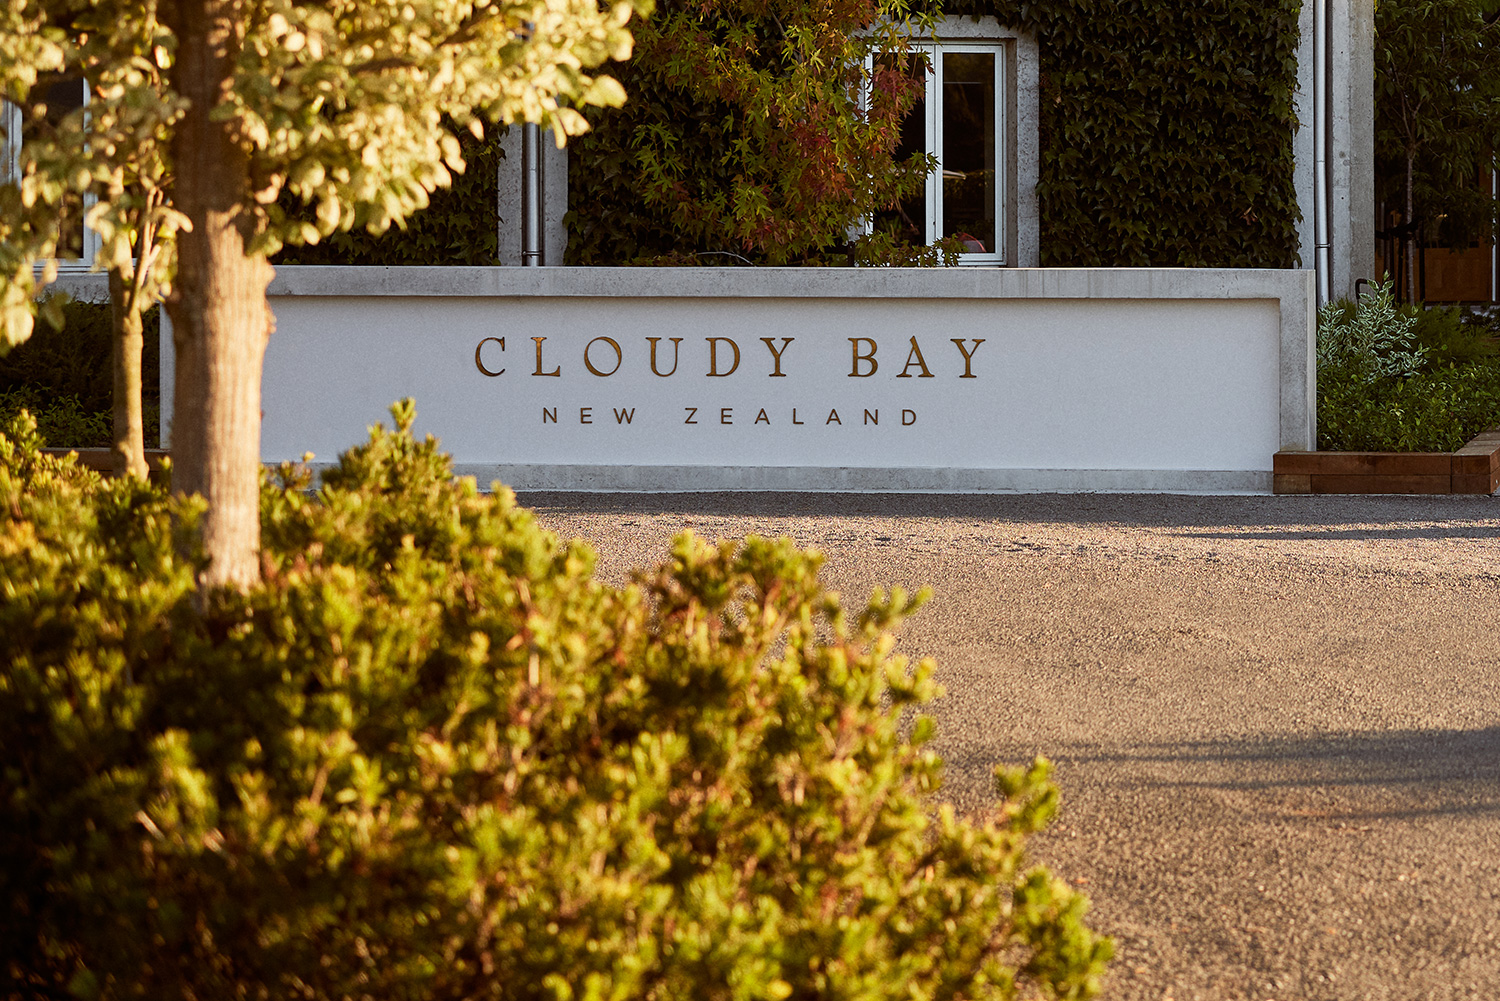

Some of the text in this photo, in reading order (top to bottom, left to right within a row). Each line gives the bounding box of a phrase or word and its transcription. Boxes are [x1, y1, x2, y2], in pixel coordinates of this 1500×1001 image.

[474, 335, 986, 379] CLOUDY BAY
[542, 407, 918, 427] NEW ZEALAND
